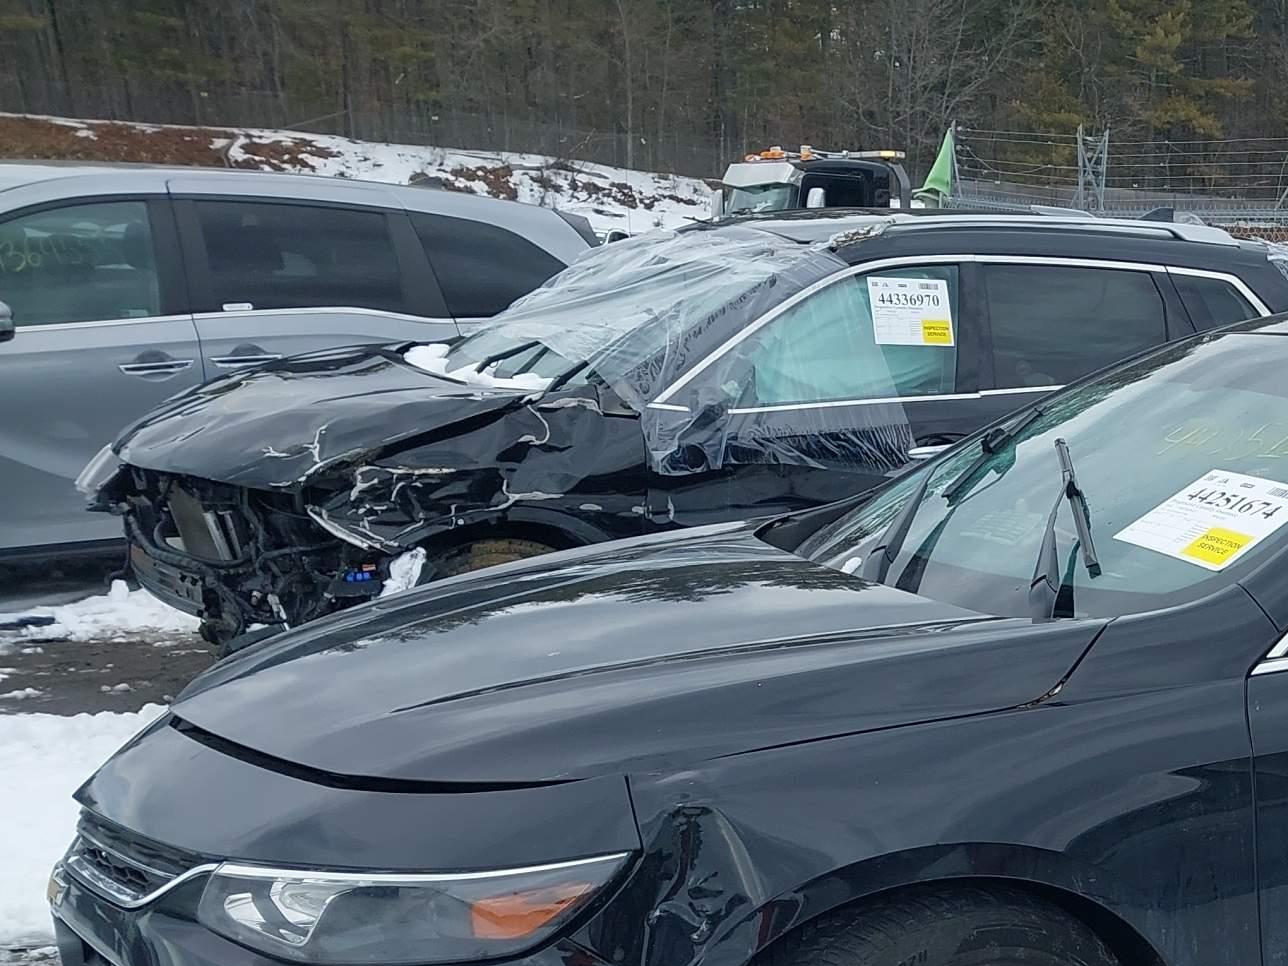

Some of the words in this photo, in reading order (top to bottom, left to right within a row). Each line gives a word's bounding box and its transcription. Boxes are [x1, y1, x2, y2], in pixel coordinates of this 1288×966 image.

[878, 292, 940, 307] 44336970
[1187, 487, 1283, 520] 44251674
[1197, 542, 1229, 556] SERVICE
[1201, 533, 1243, 550] INSPECTION
